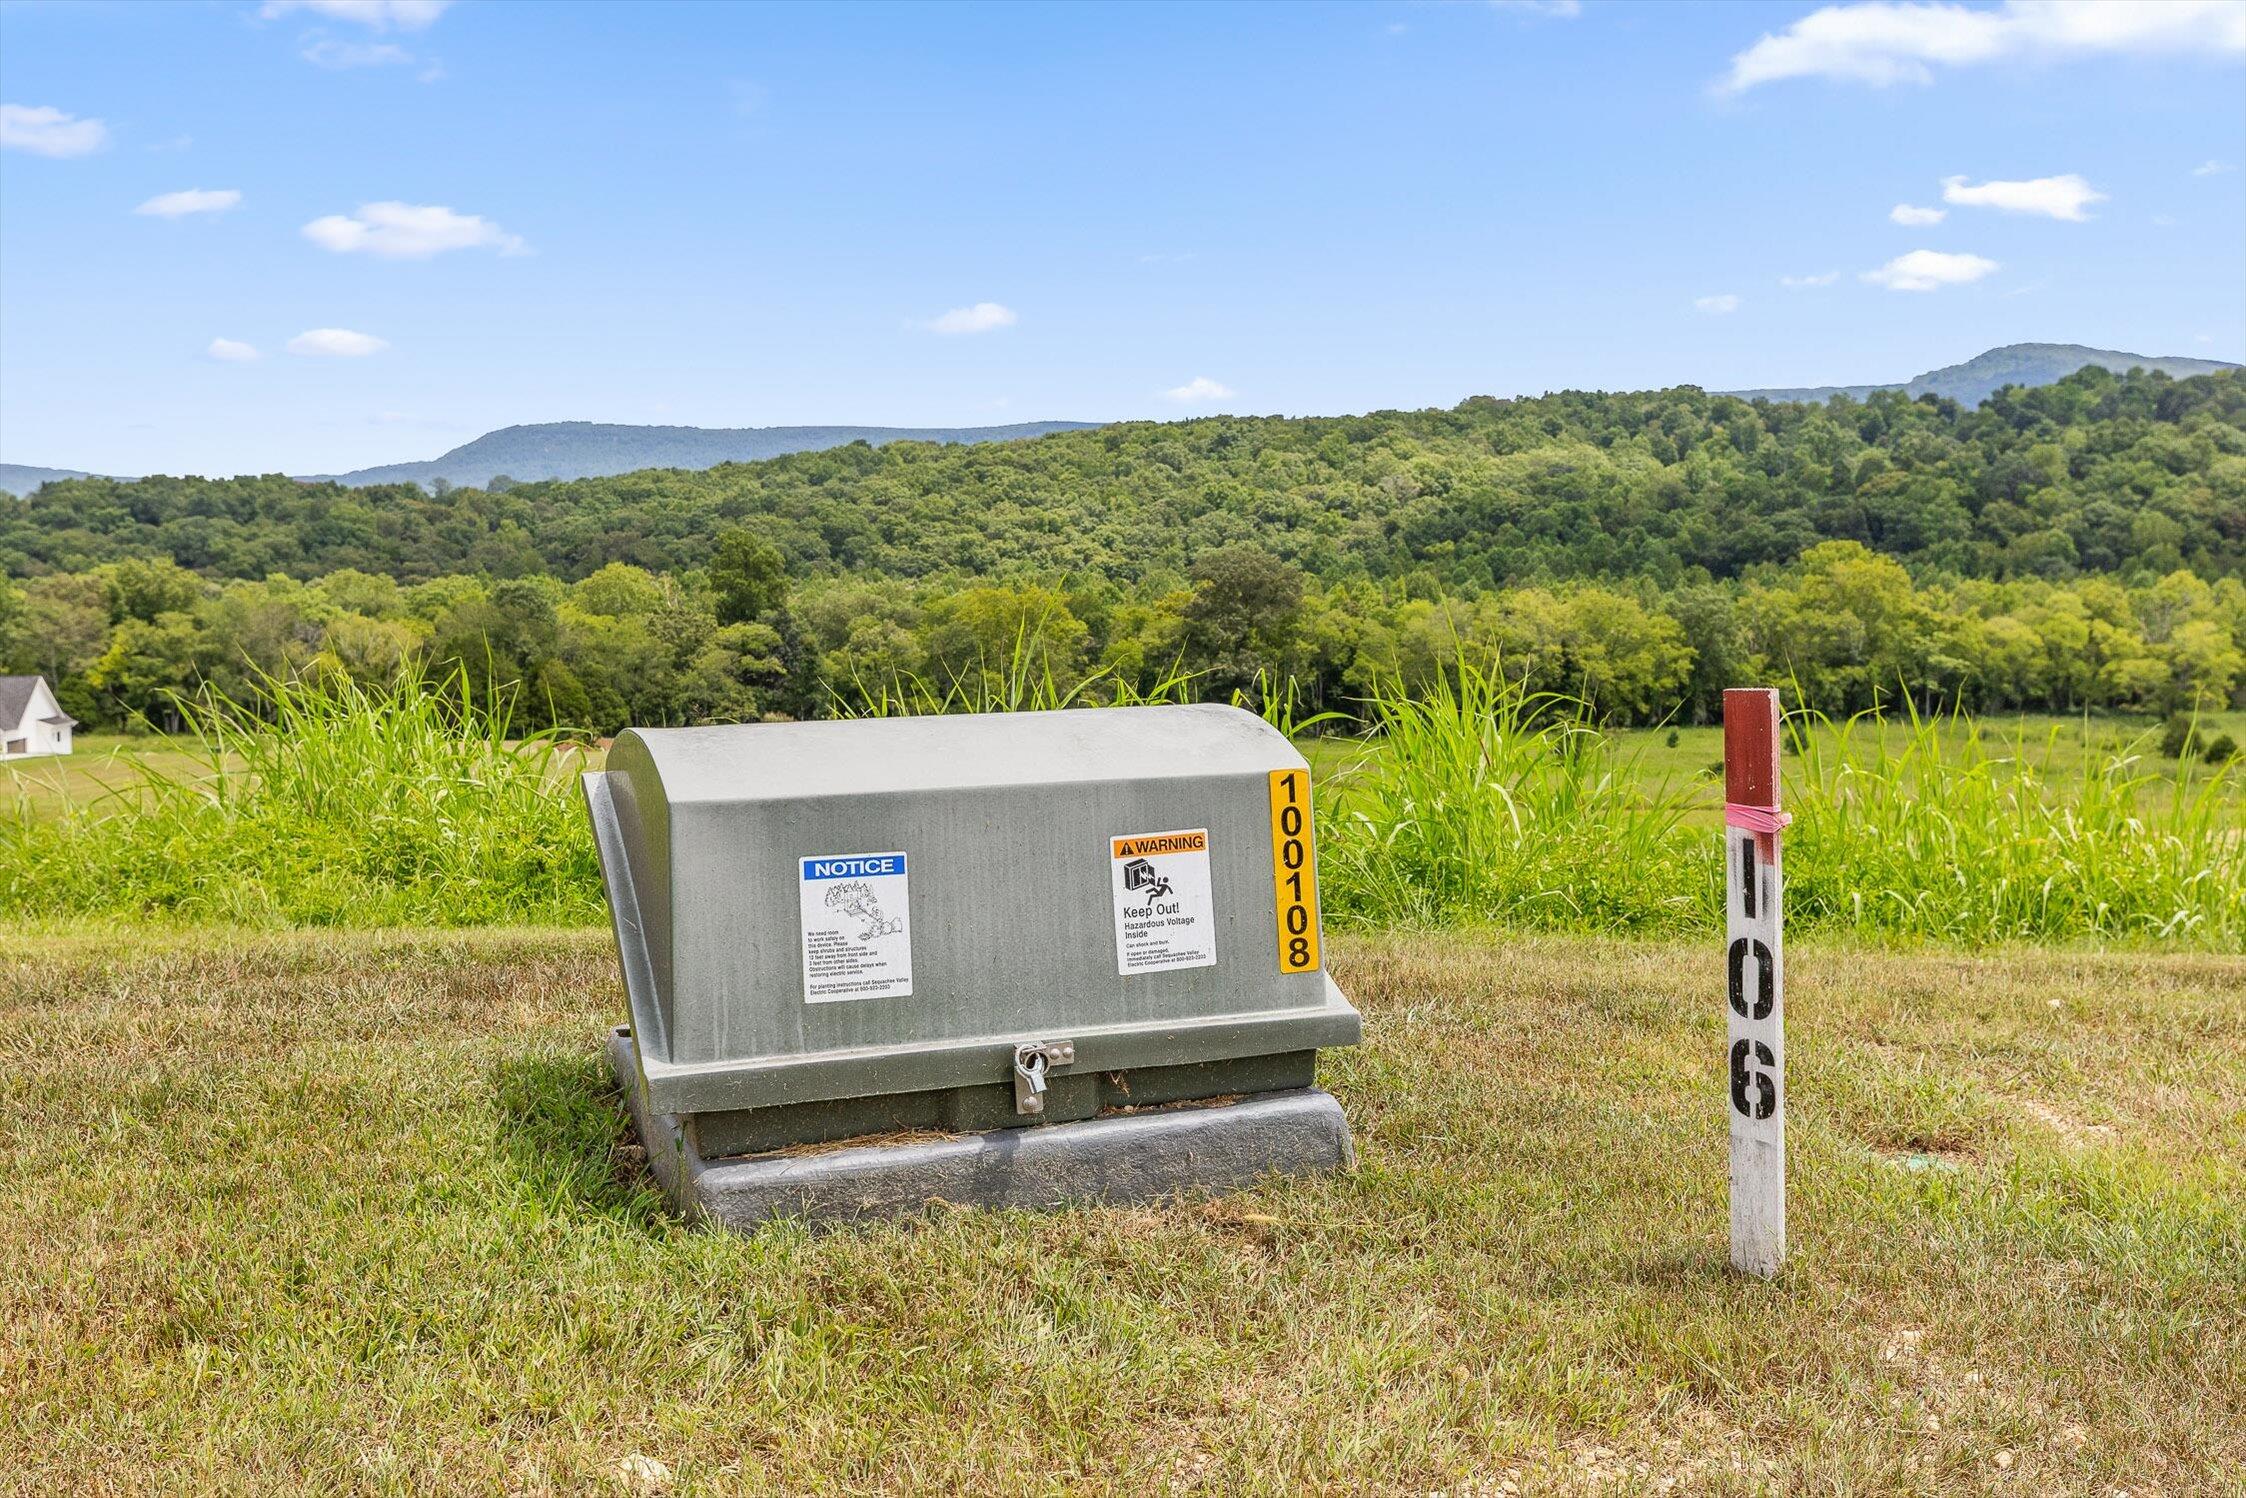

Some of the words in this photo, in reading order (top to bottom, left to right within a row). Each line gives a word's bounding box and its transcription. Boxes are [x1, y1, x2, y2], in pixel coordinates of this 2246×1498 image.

[1136, 836, 1204, 854] WARNING
[815, 858, 894, 876] NOTICE
[1279, 773, 1311, 968] 100108
[1124, 907, 1152, 918] Keep
[1156, 902, 1180, 915] Out!
[1125, 920, 1165, 930] Hazardous
[1167, 916, 1195, 925] Voltage
[1125, 930, 1148, 939] Inside
